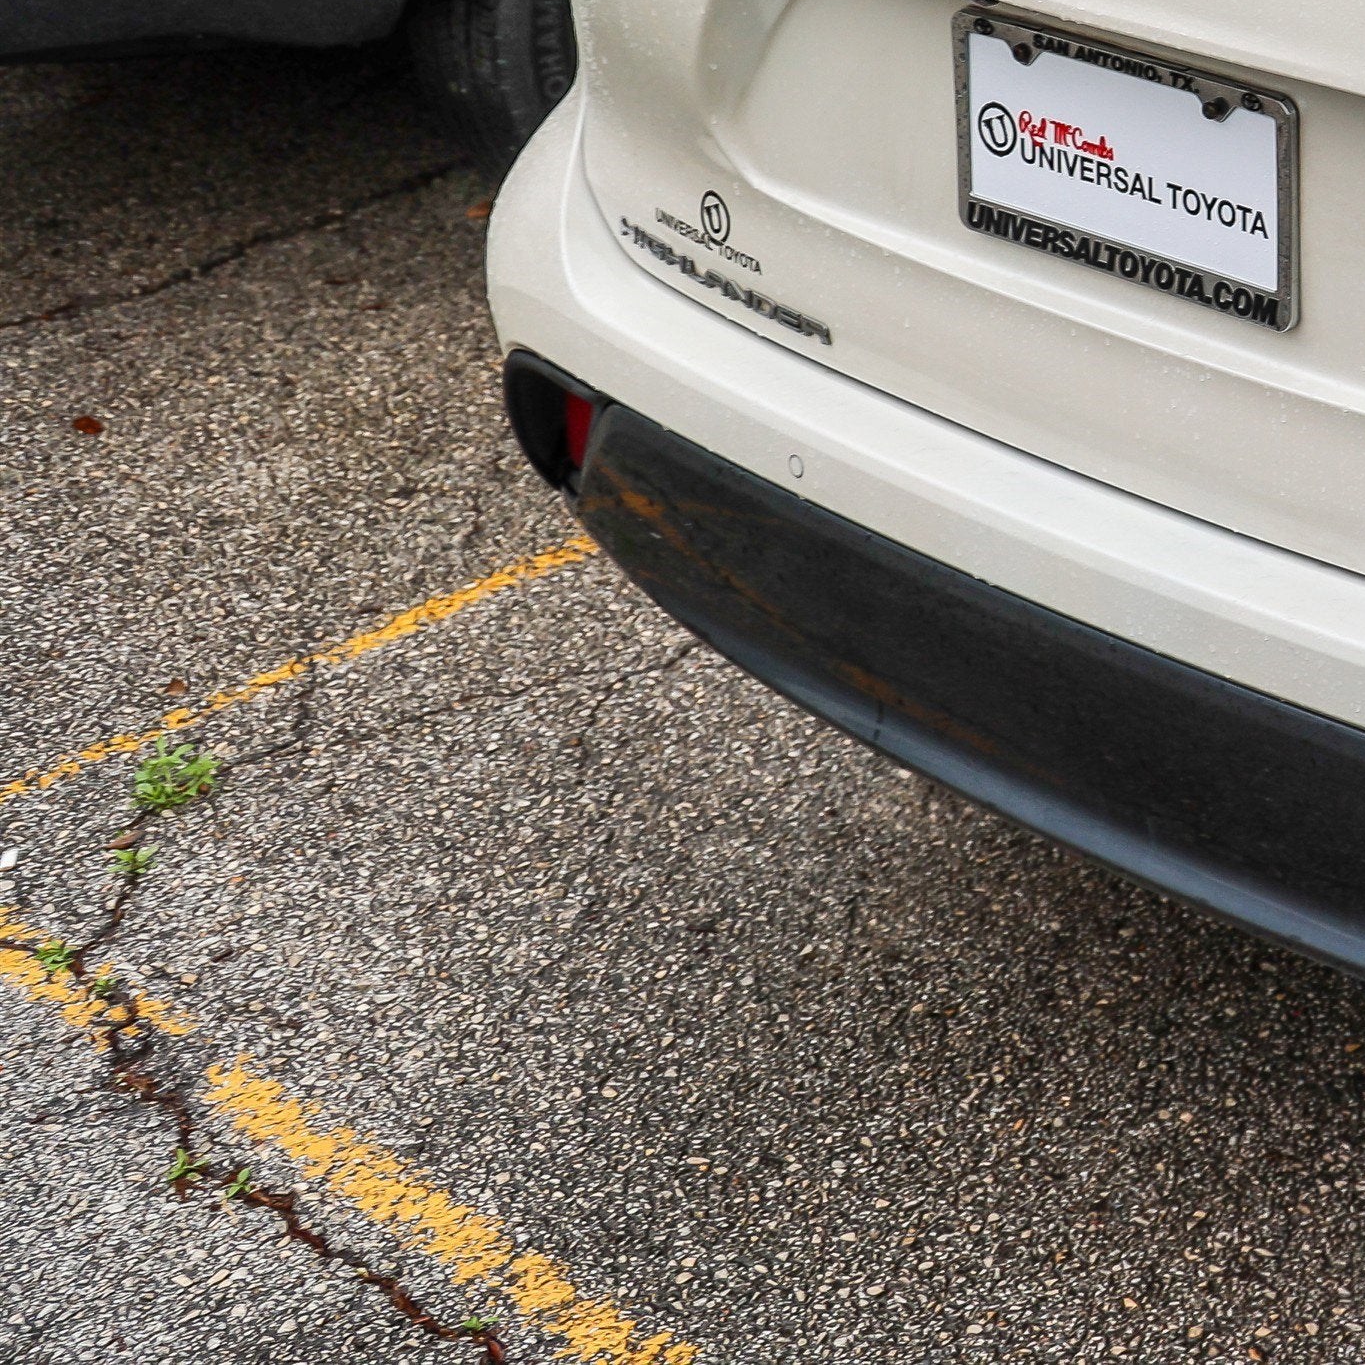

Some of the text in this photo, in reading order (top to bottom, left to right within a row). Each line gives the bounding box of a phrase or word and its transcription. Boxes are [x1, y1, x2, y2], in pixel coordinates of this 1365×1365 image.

[1033, 33, 1070, 57] SAN
[1019, 110, 1047, 142] Red
[1020, 136, 1270, 240] UNIVERSAL TOYOTA
[655, 206, 762, 276] UNIVERSAL TOYOTA
[967, 200, 1281, 328] UNIVERSALTOYOTA.COM
